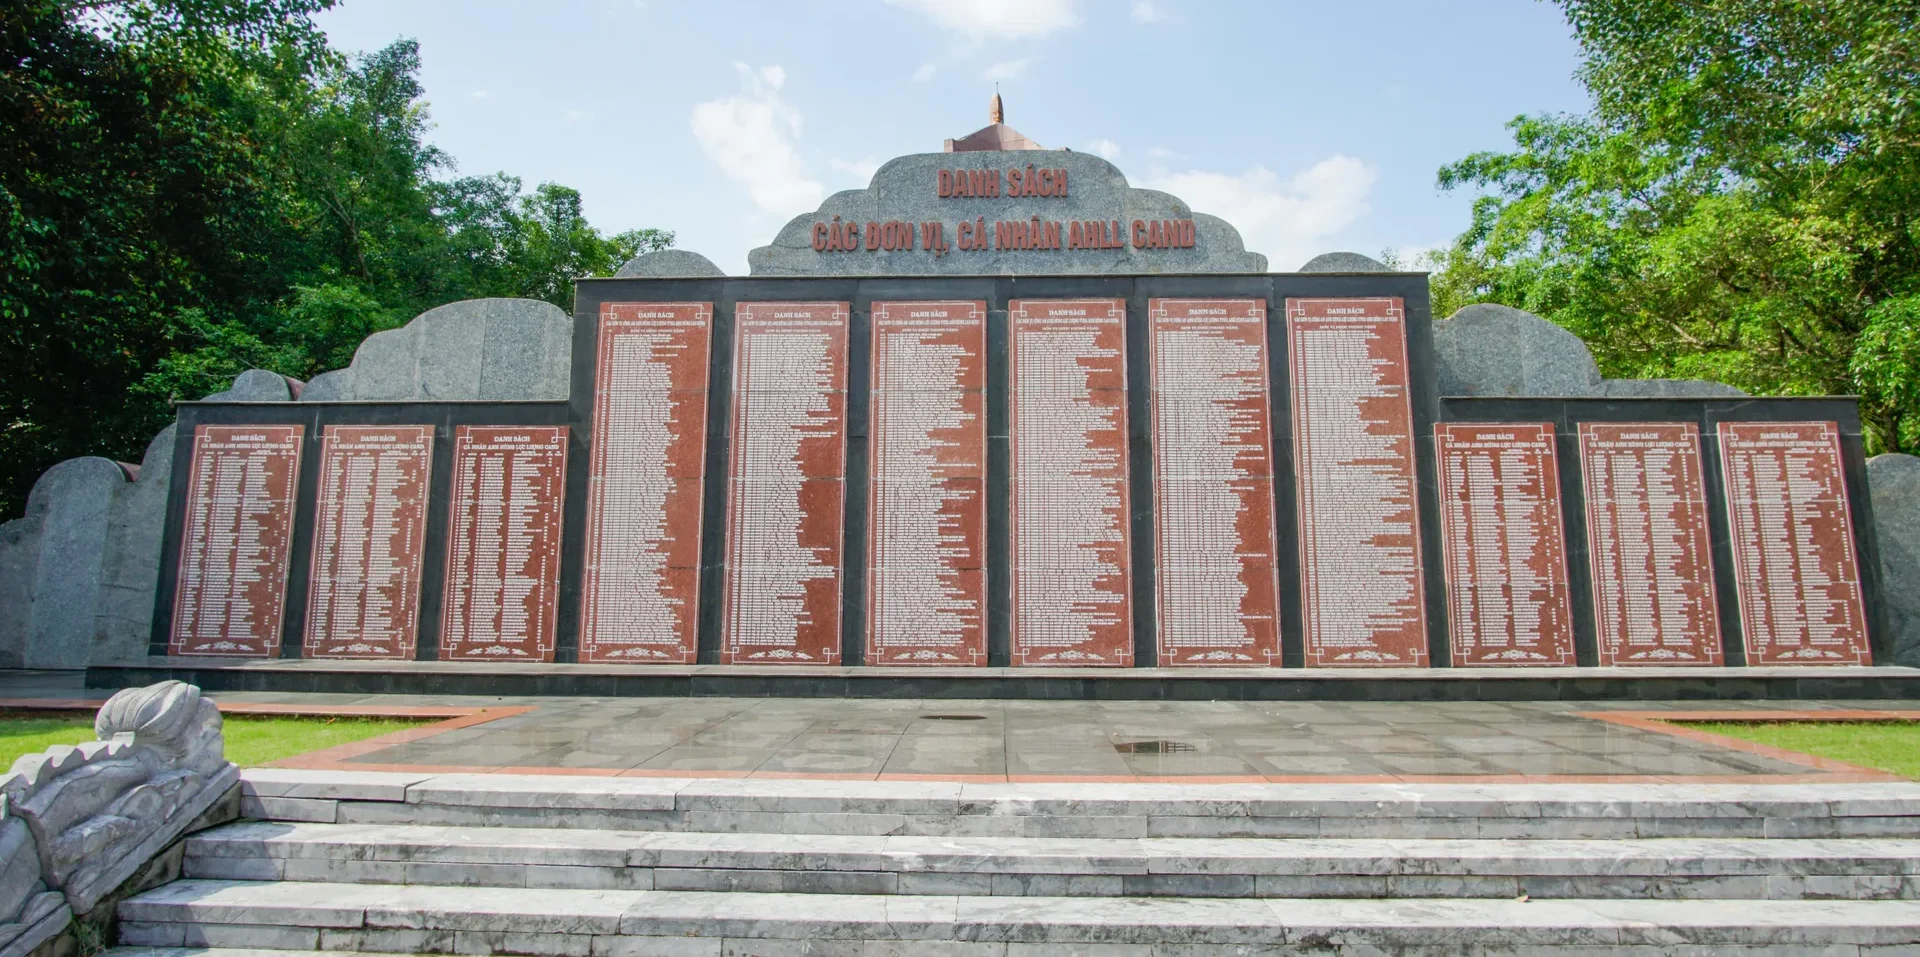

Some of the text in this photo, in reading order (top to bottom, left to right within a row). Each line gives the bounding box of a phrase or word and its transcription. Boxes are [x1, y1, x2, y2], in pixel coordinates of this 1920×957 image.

[938, 163, 1068, 197] DANH SÁCH
[812, 214, 1196, 258] CÁC ĐƠN VỊ, CÁ NHÂN AHLL CAND
